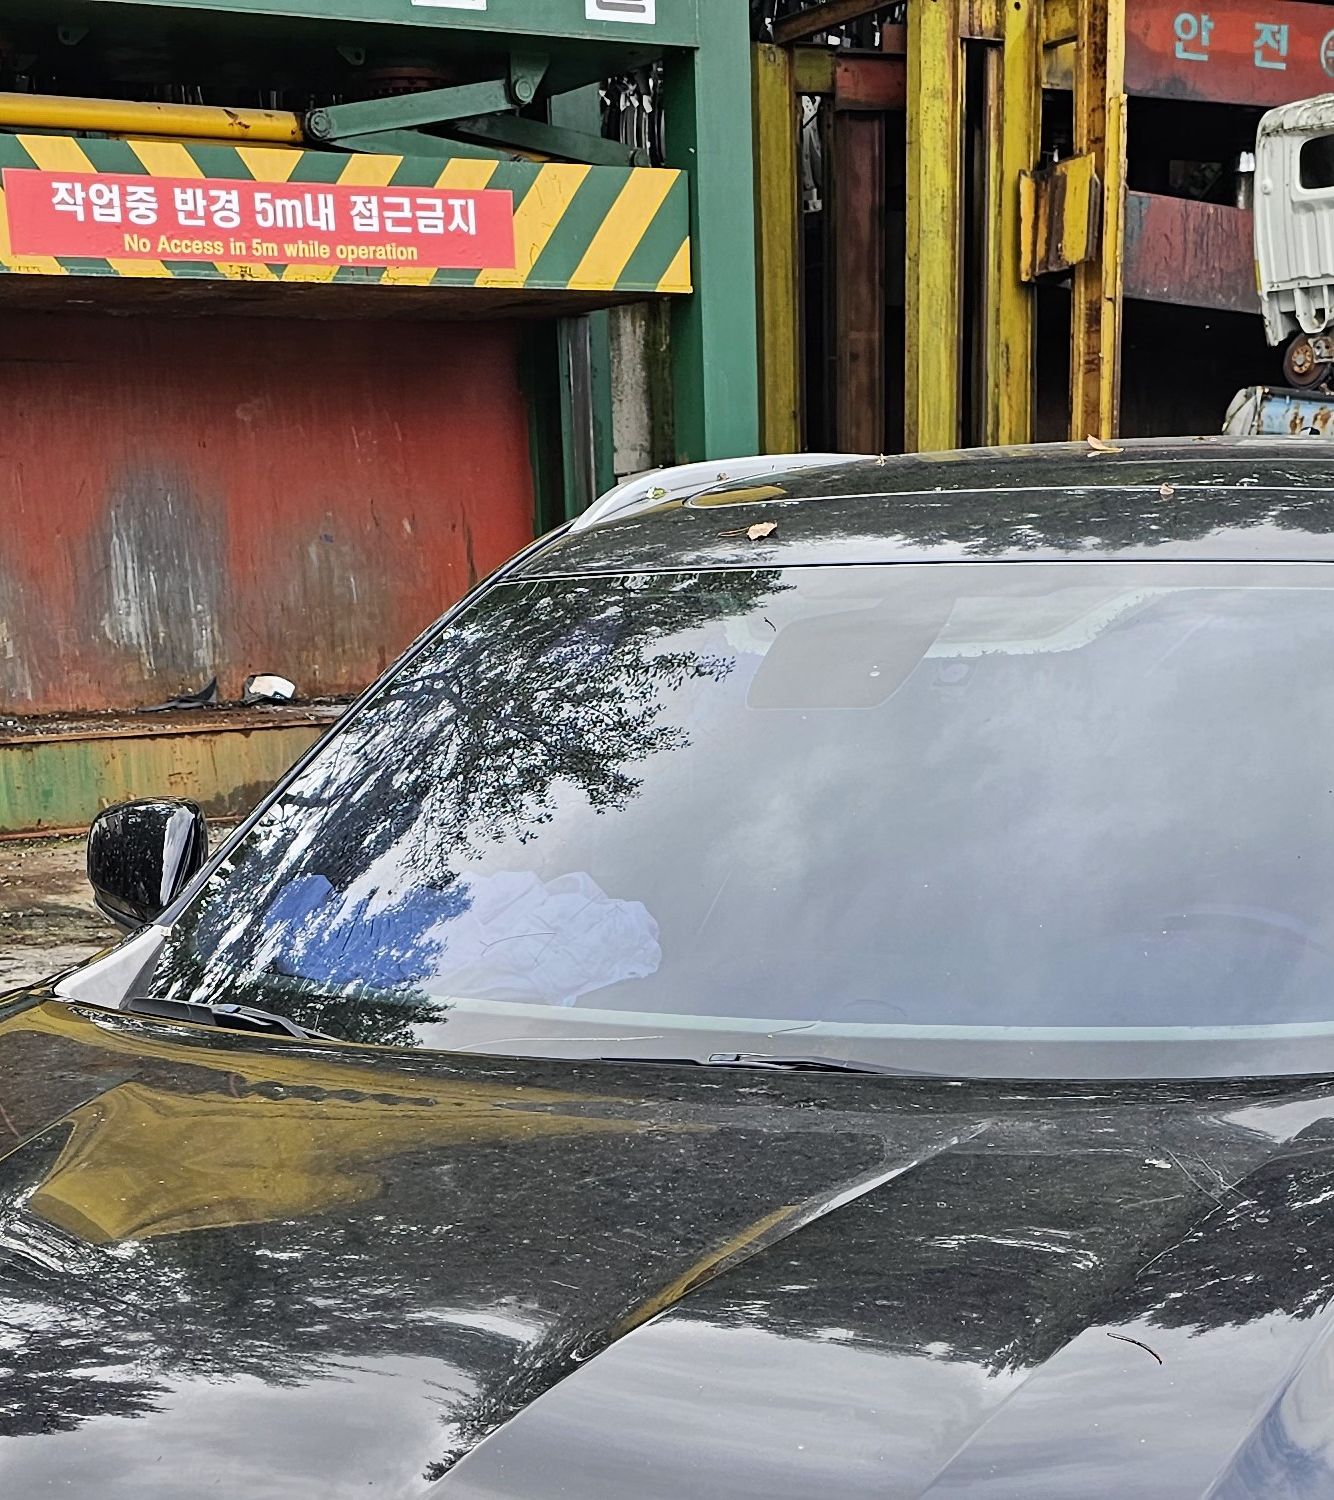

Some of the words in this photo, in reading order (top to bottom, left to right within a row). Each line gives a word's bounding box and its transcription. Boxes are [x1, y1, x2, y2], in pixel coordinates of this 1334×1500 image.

[51, 182, 158, 225] 작업중
[173, 187, 241, 228] 반경
[254, 192, 336, 232] 5m내
[349, 195, 477, 235] 접근금지
[124, 234, 151, 253] No
[157, 235, 224, 255] Access
[230, 238, 246, 255] in
[251, 239, 278, 257] 5m
[283, 240, 330, 259] while
[336, 243, 418, 262] operation
